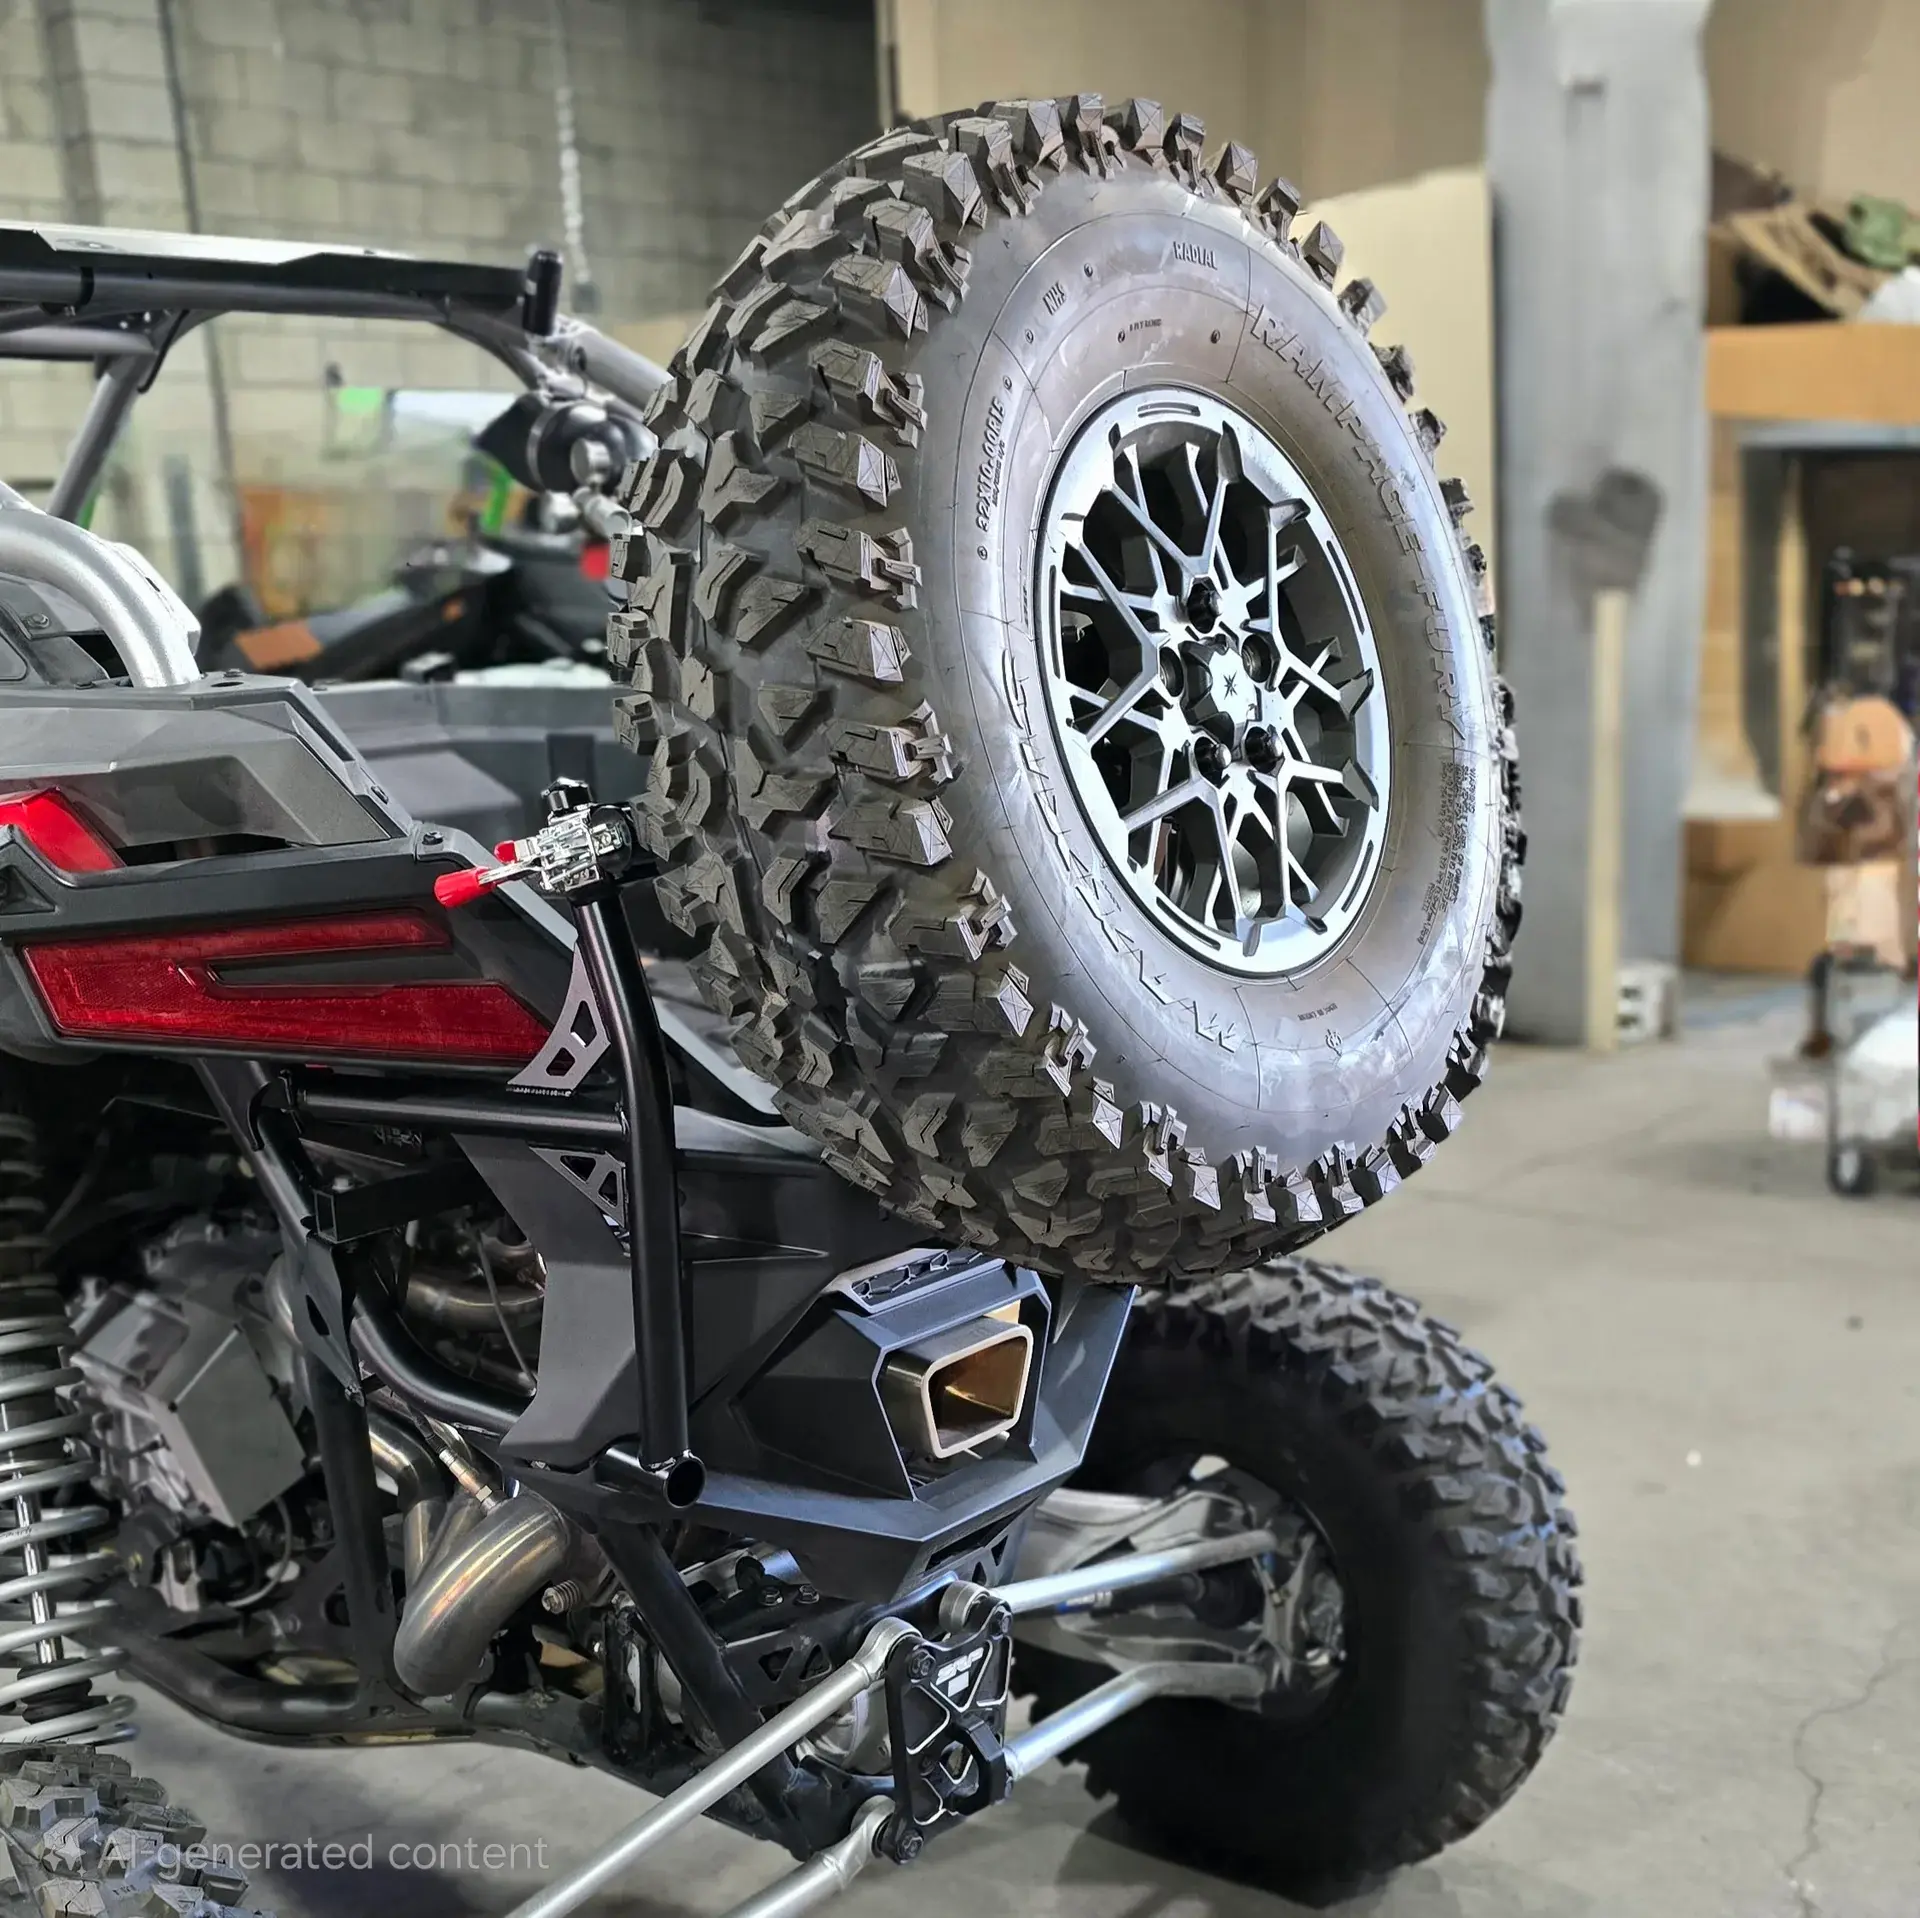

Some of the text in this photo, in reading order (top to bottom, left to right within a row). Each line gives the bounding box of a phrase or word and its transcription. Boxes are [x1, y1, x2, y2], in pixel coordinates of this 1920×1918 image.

[1173, 241, 1218, 270] RADIAL
[1042, 280, 1067, 315] NHS
[1250, 303, 1466, 741] RAMPAGE FURY
